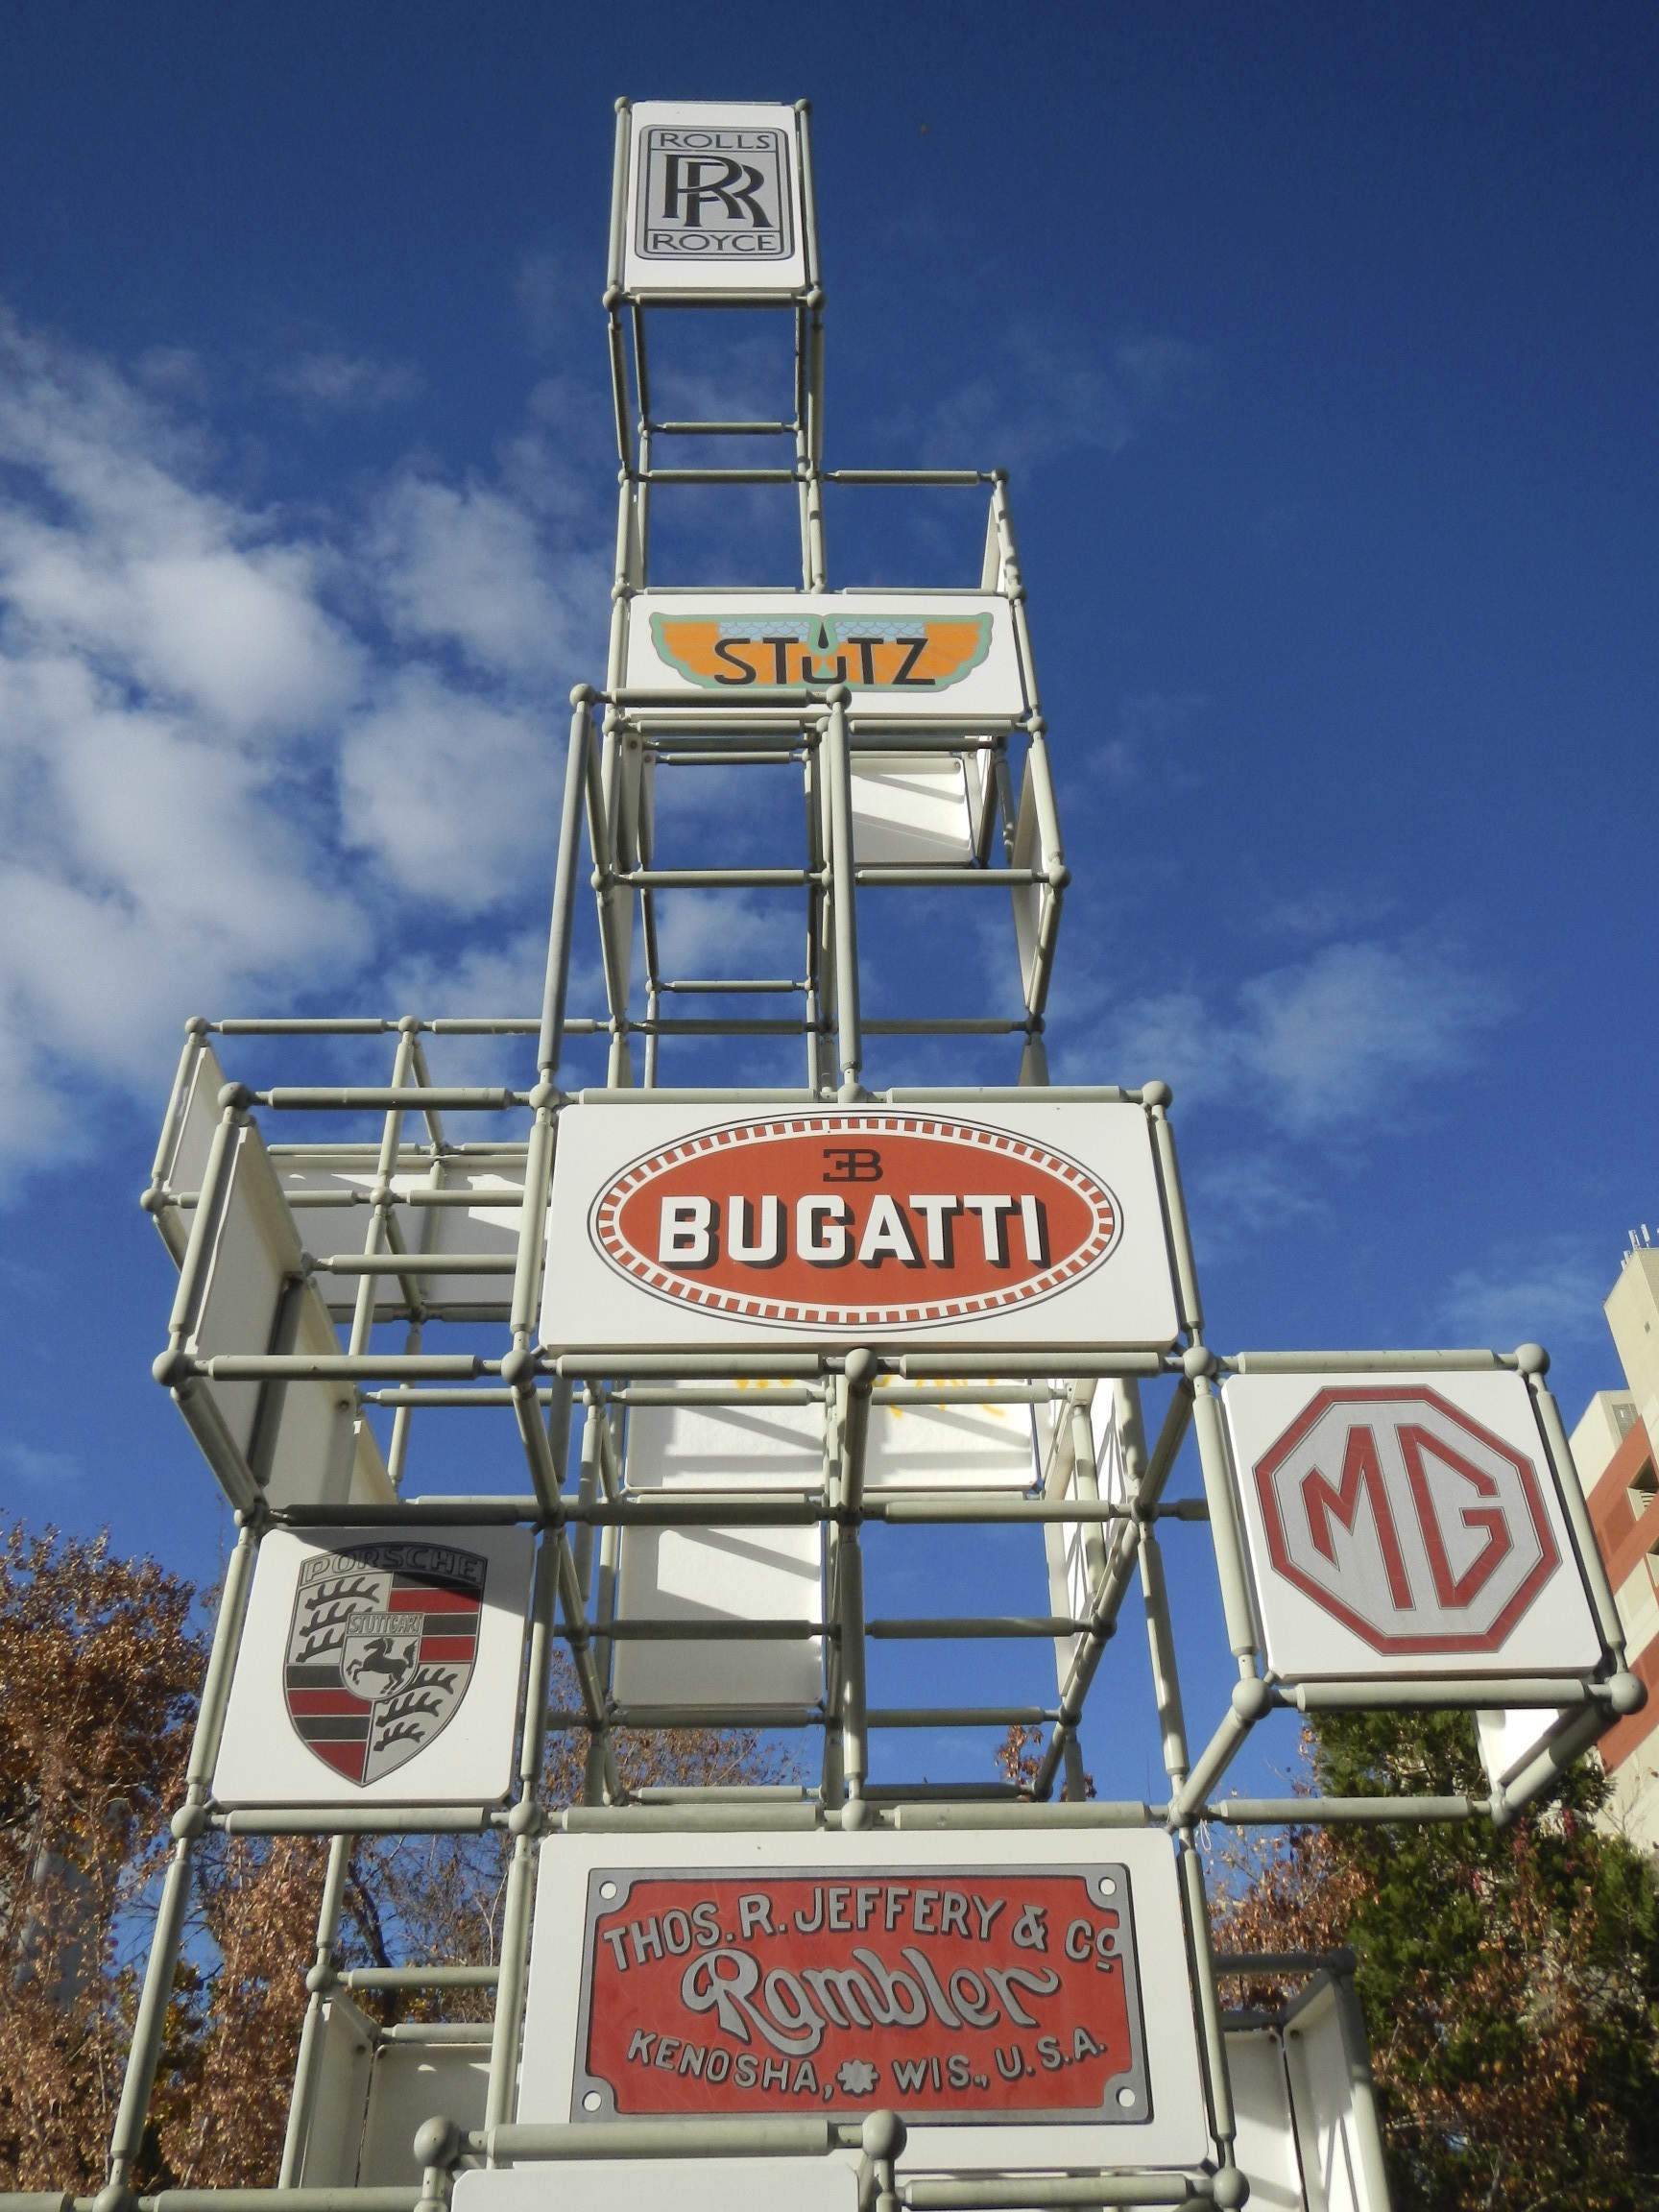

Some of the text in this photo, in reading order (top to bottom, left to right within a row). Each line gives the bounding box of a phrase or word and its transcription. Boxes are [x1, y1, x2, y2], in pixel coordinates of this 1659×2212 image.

[660, 132, 771, 150] ROLLS
[652, 233, 777, 252] ROYCE
[713, 637, 936, 685] STUTZ
[658, 1193, 1052, 1269] BUGATTI
[1299, 1423, 1515, 1612] MG
[302, 1547, 479, 1582] PORSCHE
[349, 1613, 421, 1634] STUTTGART
[602, 1901, 735, 1973] THOS.
[738, 1892, 787, 1940] R.
[793, 1886, 1006, 1941] JEFFERY
[1012, 1903, 1049, 1953] &
[681, 1946, 1063, 2057] Rambler
[626, 2028, 834, 2102] KENOSHA,
